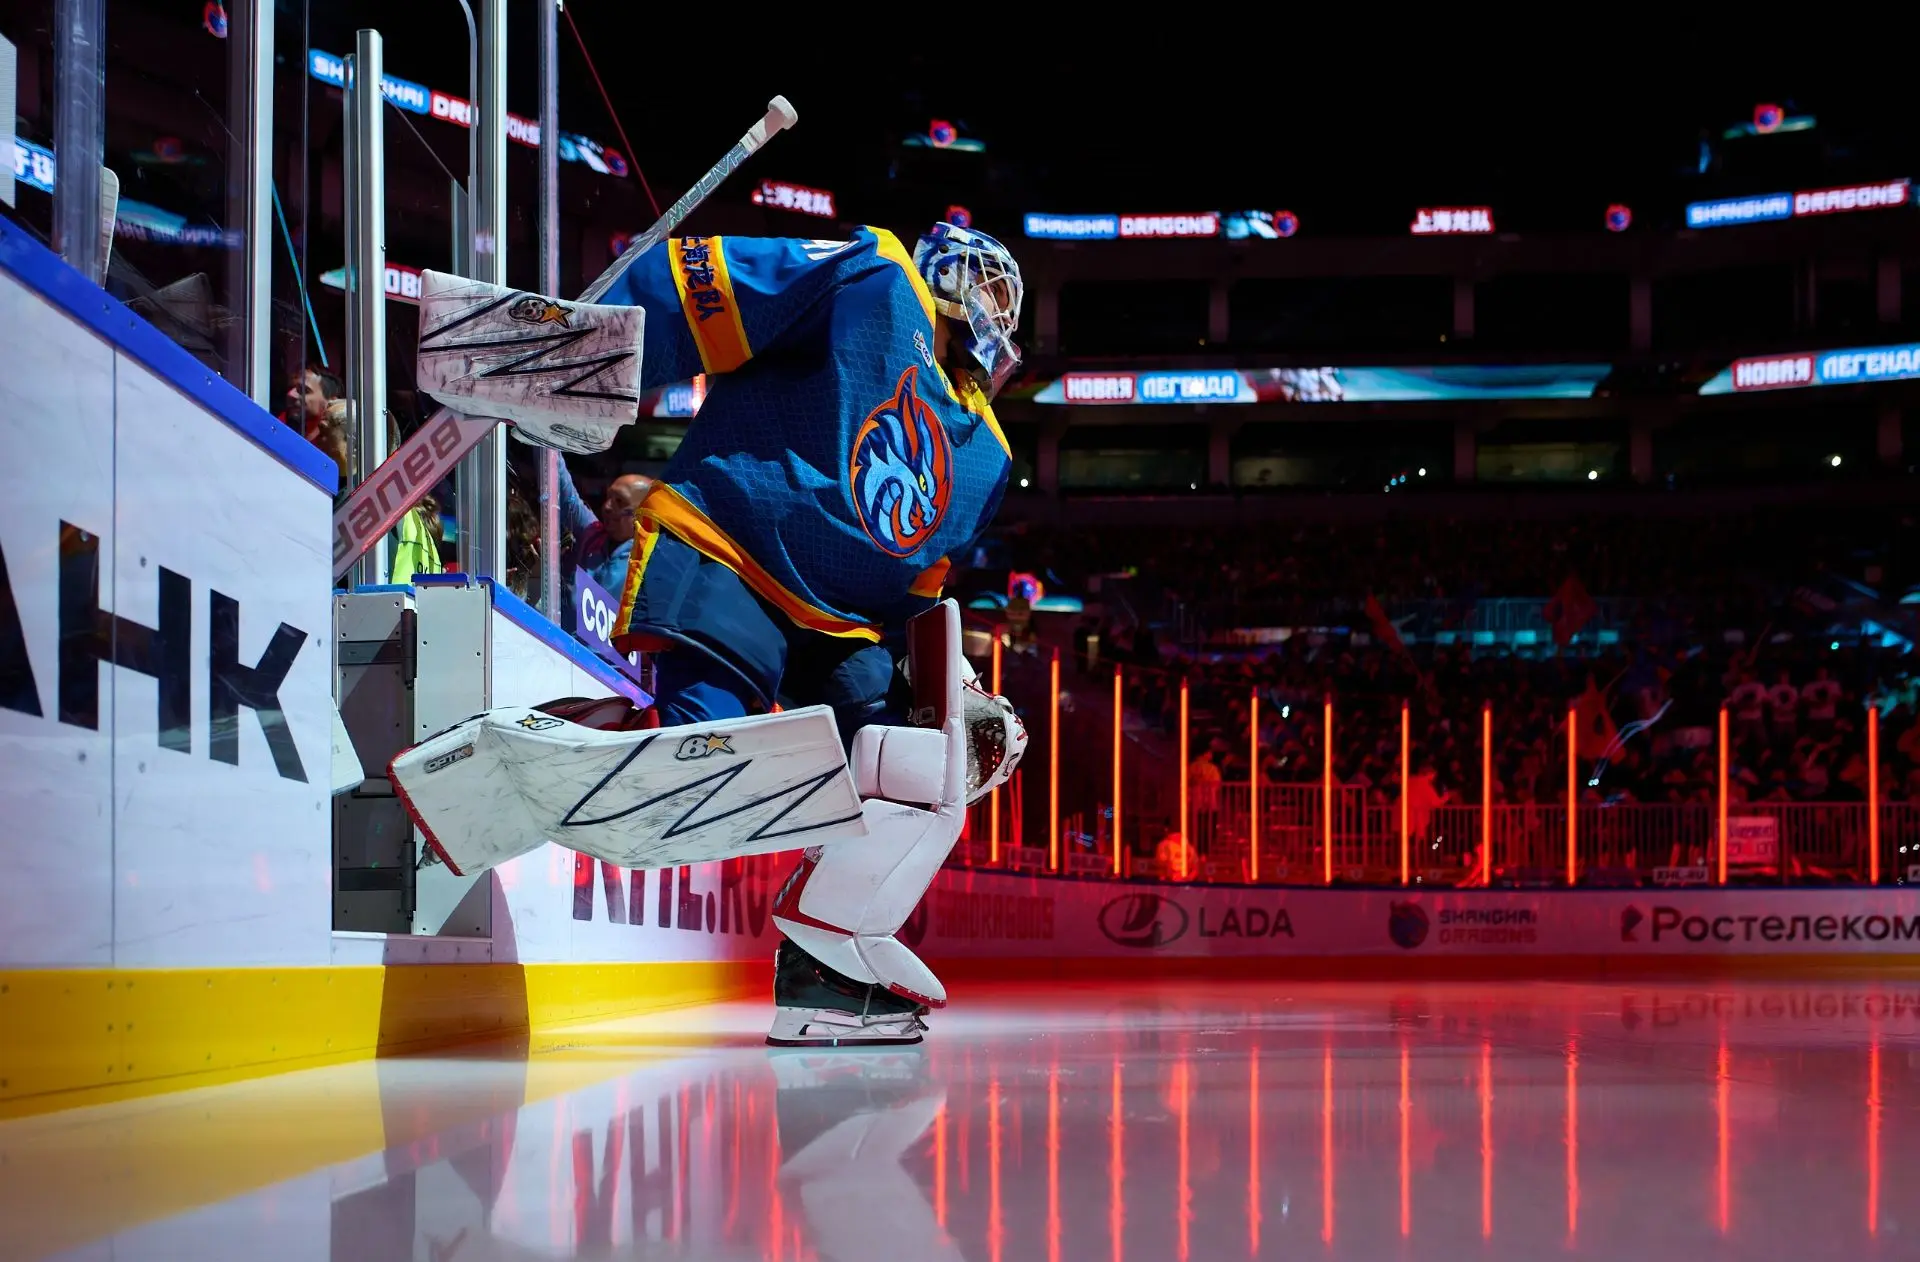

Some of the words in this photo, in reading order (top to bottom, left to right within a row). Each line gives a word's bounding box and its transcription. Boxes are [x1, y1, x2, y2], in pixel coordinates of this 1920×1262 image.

[1690, 197, 1789, 224] SHANGHAI
[1795, 183, 1904, 214] DRAGONS
[1027, 216, 1115, 234] SHANGHAI
[1120, 215, 1215, 236] DRAGONS
[1736, 357, 1812, 388] НОВАЯ
[1066, 377, 1133, 400] НОВАЯ
[1199, 907, 1296, 939] LADA
[1438, 908, 1538, 925] SHANGHAI
[1651, 906, 1920, 942] Ростелеком
